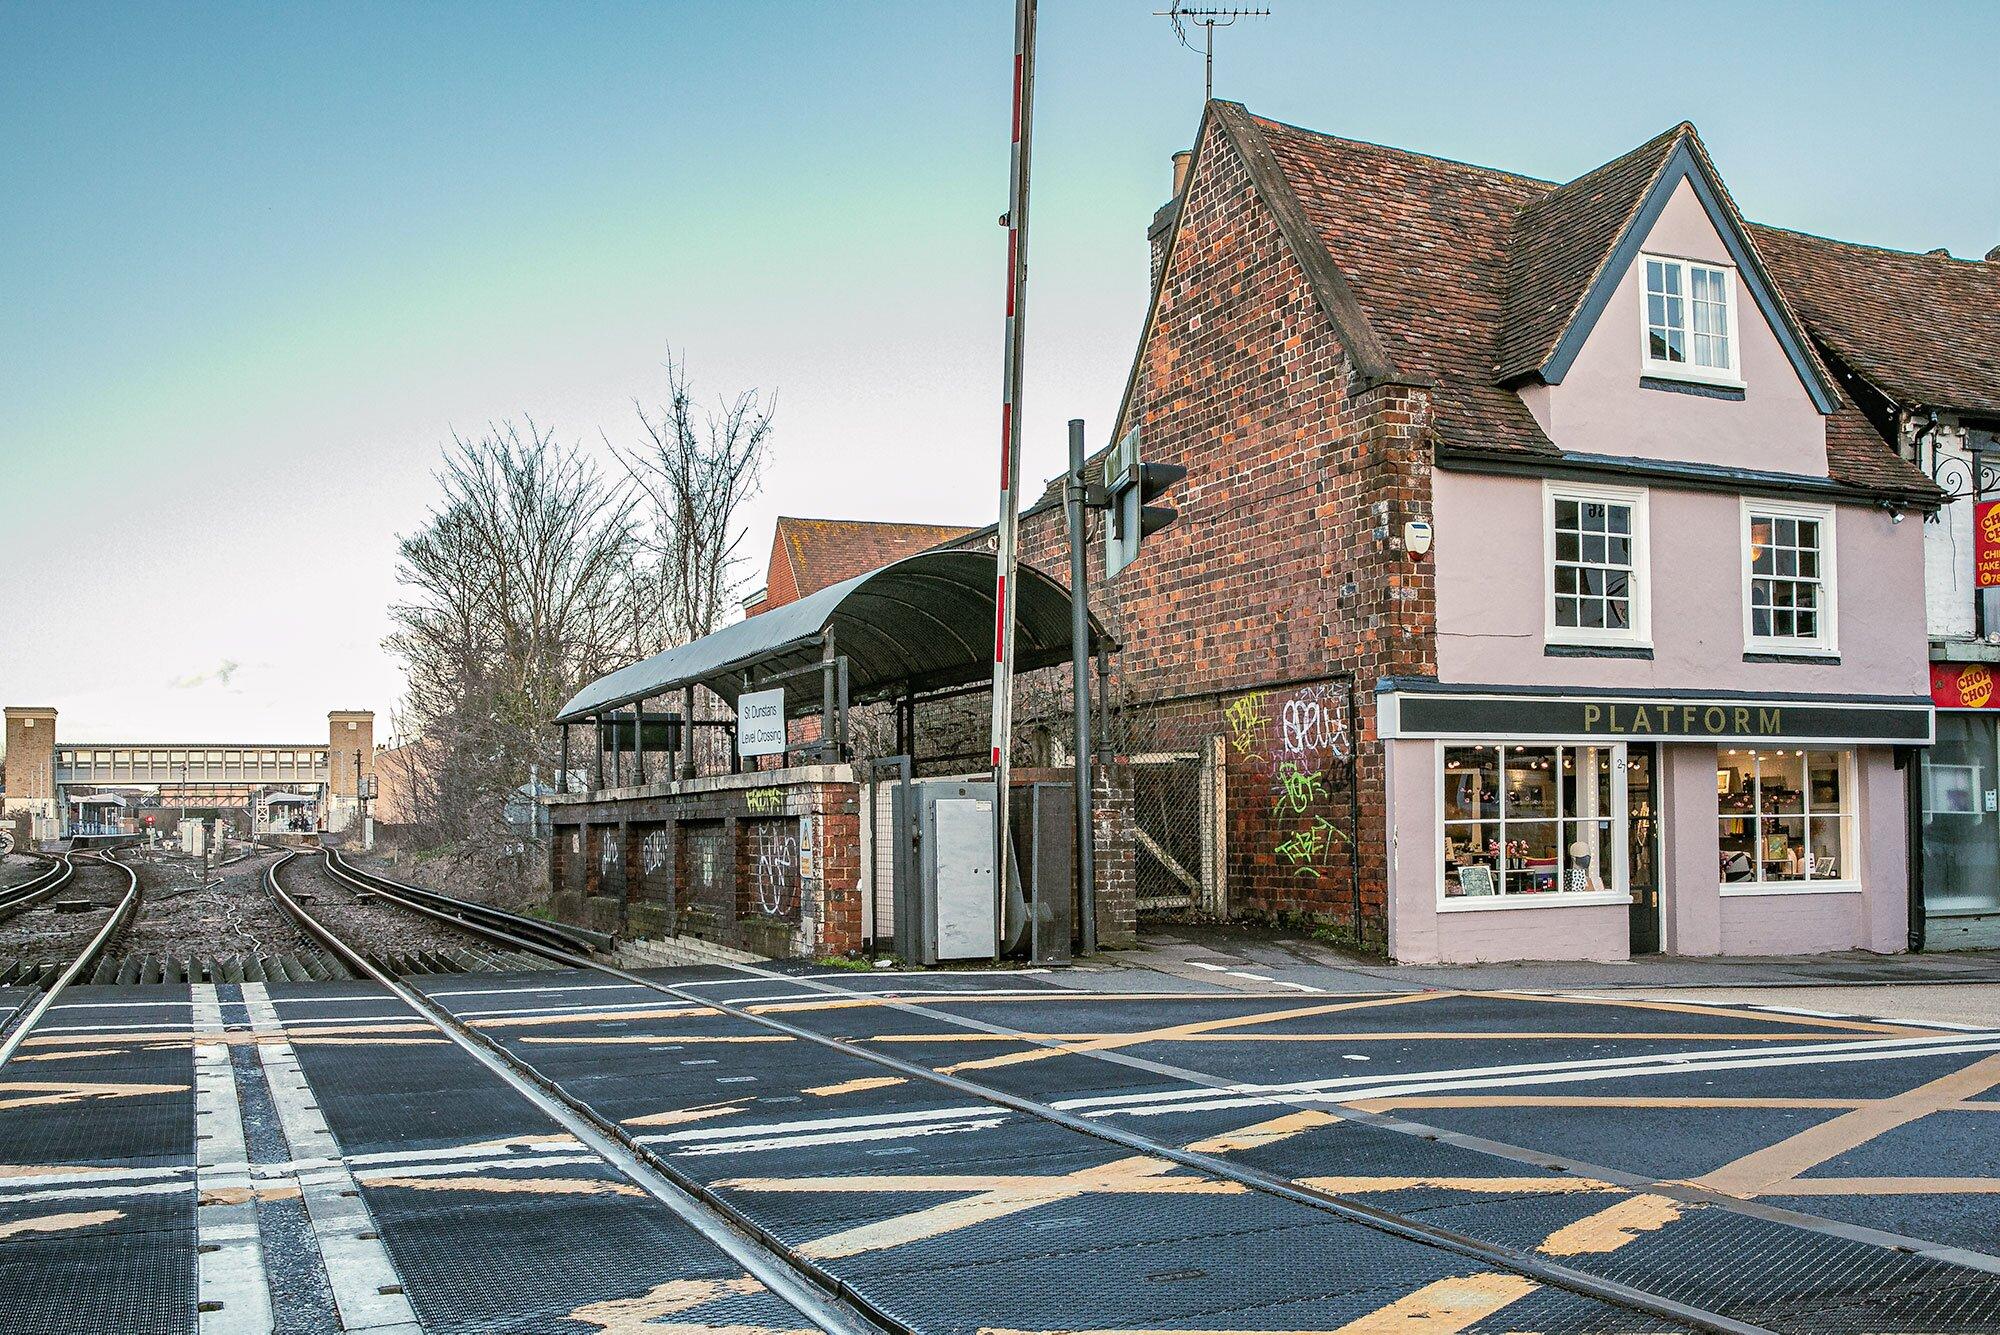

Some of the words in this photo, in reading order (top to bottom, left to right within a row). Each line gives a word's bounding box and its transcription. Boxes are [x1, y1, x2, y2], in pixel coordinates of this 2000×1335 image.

[1984, 549, 2000, 560] CHI
[1978, 560, 2000, 571] TAKE
[1958, 668, 1990, 690] CHOP
[1961, 682, 1991, 704] CHOP
[744, 706, 751, 719] St
[752, 704, 777, 719] Dunstans
[1584, 704, 1781, 734] PLATFORM
[742, 730, 756, 744] Level
[757, 728, 782, 744] Crossing
[1617, 758, 1626, 773] 27
